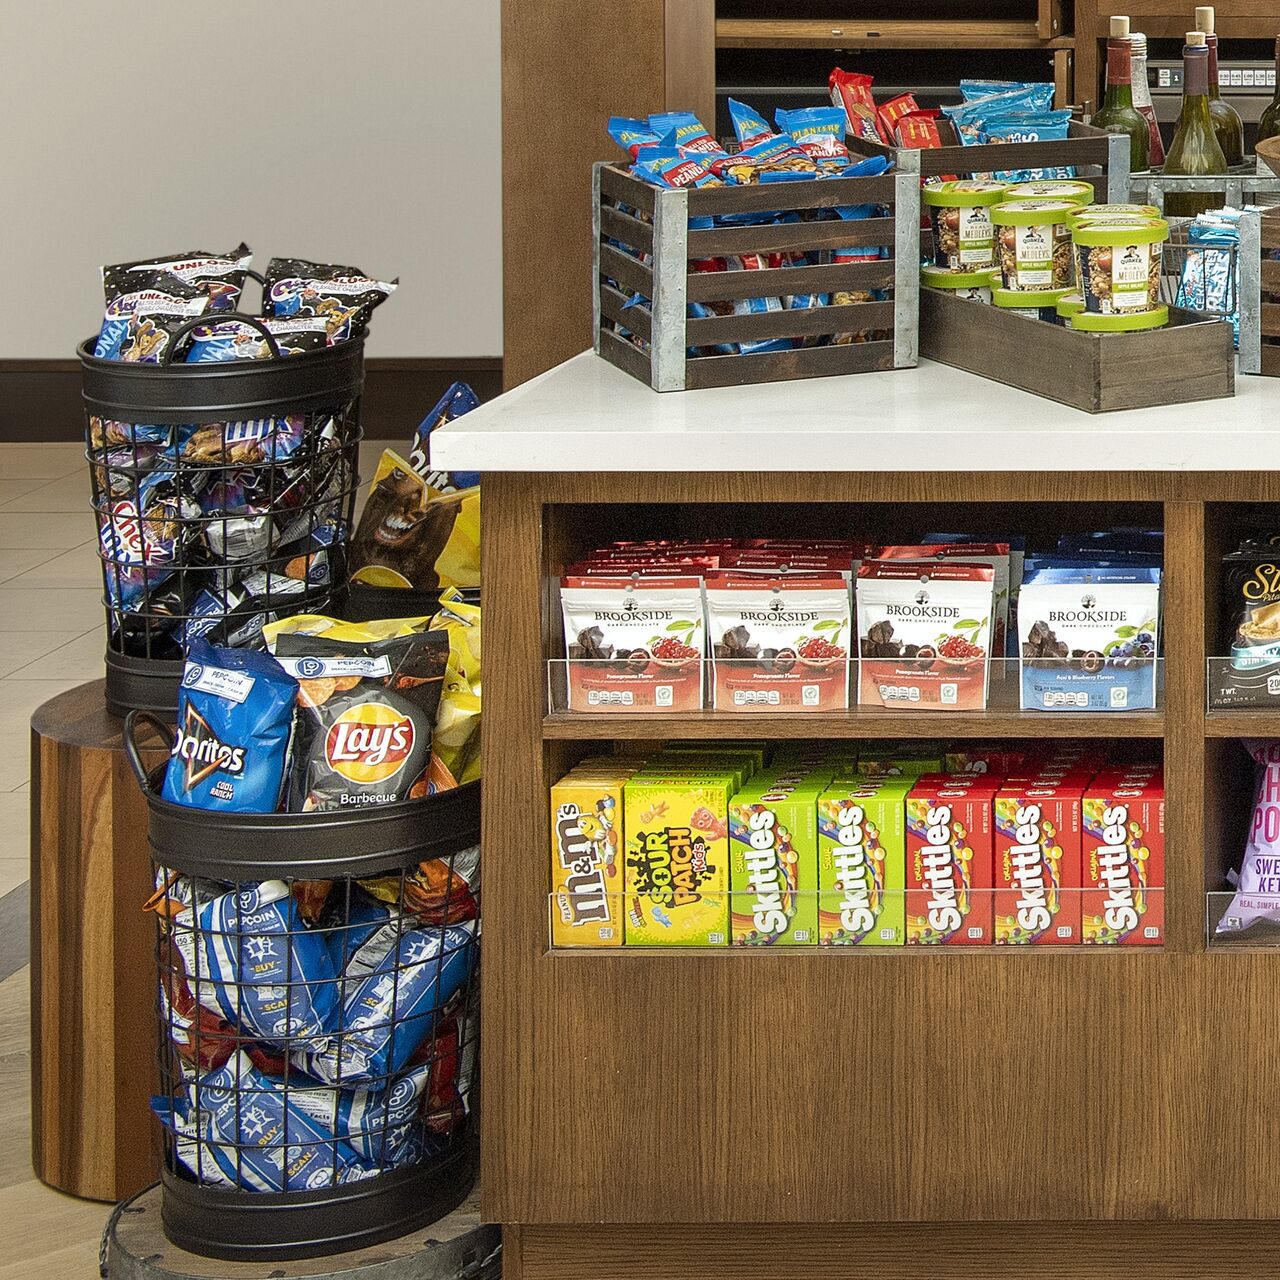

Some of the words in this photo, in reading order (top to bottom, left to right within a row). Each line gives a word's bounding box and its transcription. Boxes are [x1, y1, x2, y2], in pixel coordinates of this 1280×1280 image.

[593, 610, 673, 622] BROOKSIDE
[740, 610, 819, 622] BROOKSIDE
[331, 721, 409, 767] Lay's
[210, 788, 234, 800] RANCH
[216, 780, 235, 790] COOL
[340, 792, 397, 806] Barbecue
[646, 832, 673, 905] SOUR
[671, 826, 693, 907] PATCH
[692, 842, 707, 874] Kids
[833, 804, 876, 933] Skittles
[745, 809, 788, 934] Skittles
[253, 960, 276, 974] BUY
